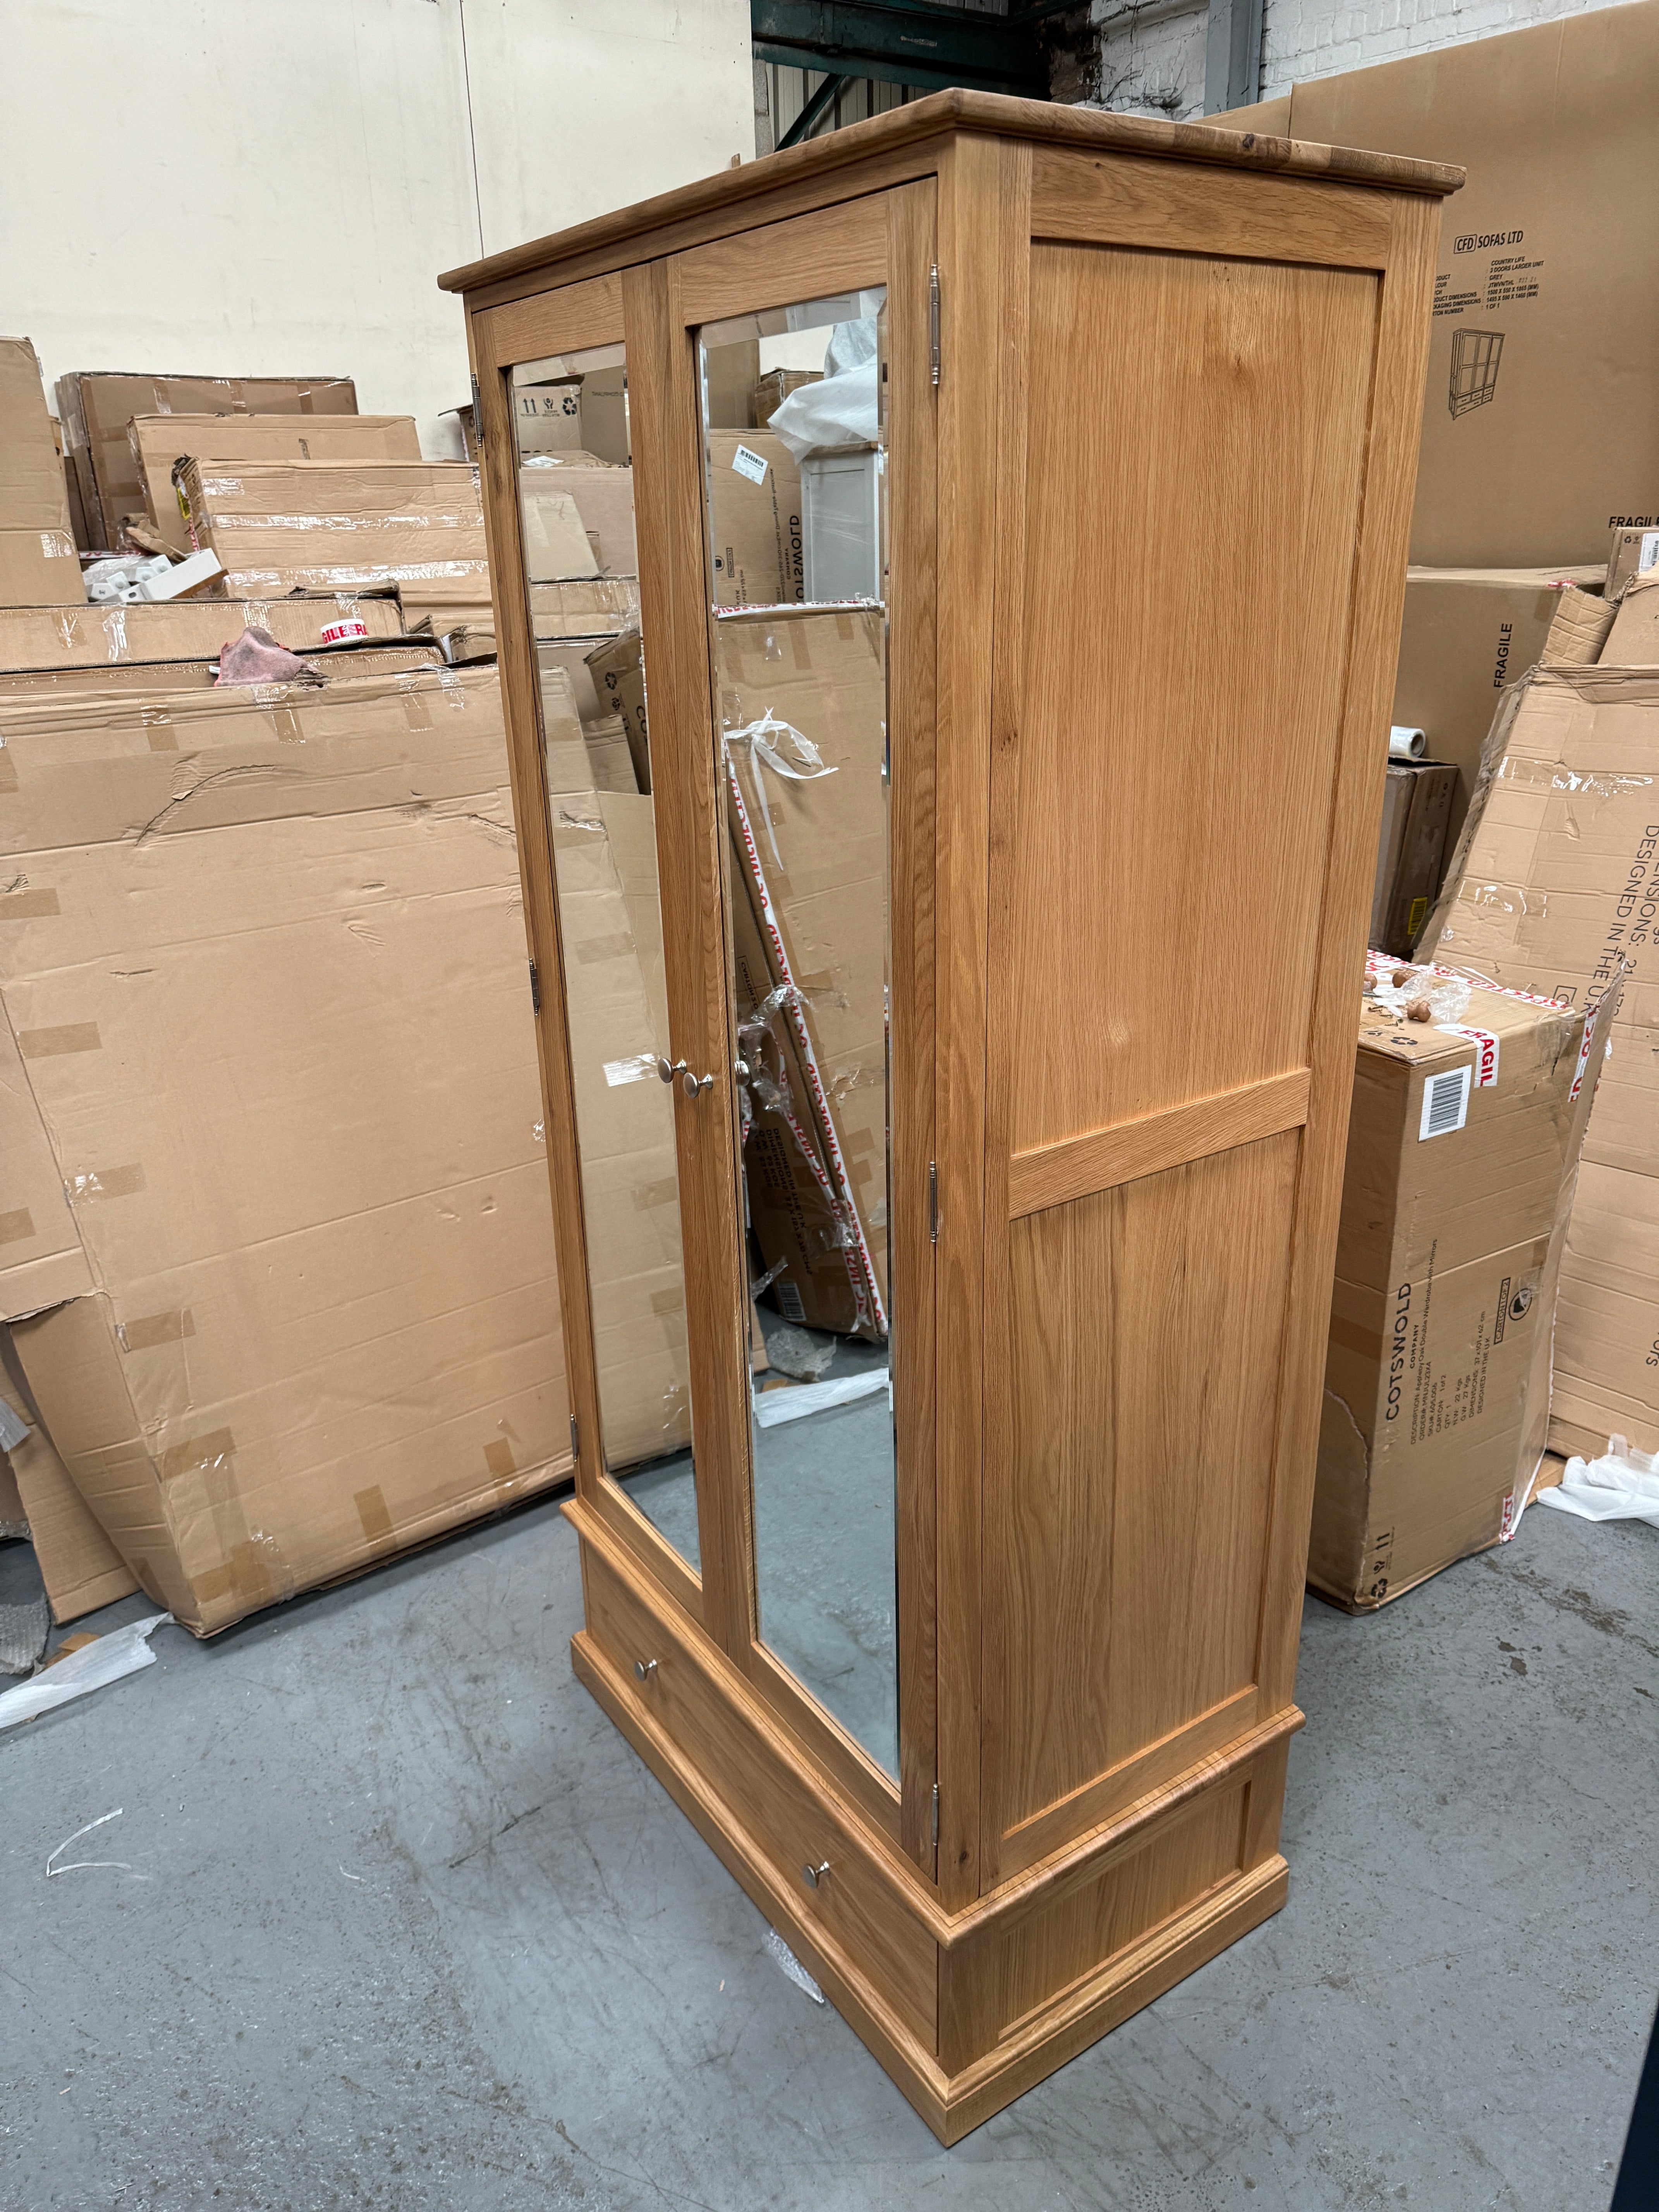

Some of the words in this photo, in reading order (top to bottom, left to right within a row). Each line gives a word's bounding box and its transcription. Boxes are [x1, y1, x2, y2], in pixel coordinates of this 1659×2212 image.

[1456, 237, 1474, 251] CFD
[1477, 232, 1506, 249] SOFAS
[1507, 230, 1524, 244] LTD
[1491, 258, 1514, 266] COUNTRY
[1494, 264, 1511, 273] DOORS
[1512, 262, 1532, 270] LARDER
[1449, 292, 1477, 301] DIMENSIONS
[1453, 298, 1481, 307] DIMENSIONS
[1494, 623, 1512, 687] FRAGILE
[1617, 825, 1659, 918] DESIGNED
[1607, 922, 1626, 941] IN
[1593, 946, 1619, 981] THE
[1415, 1362, 1424, 1391] Appleby
[1423, 1283, 1432, 1319] Wardrobe
[1429, 1239, 1438, 1266] Mirrors
[1480, 1311, 1486, 1322] cm
[1496, 1305, 1506, 1340] CARTON
[1478, 1324, 1484, 1334] 62
[1386, 1283, 1412, 1422] COTSWOLD
[1410, 1324, 1419, 1369] COMPANY
[1474, 1357, 1480, 1366] 37
[1481, 1366, 1487, 1375] IN
[1455, 1394, 1460, 1403] 22
[1477, 1375, 1486, 1414] DESIGNED
